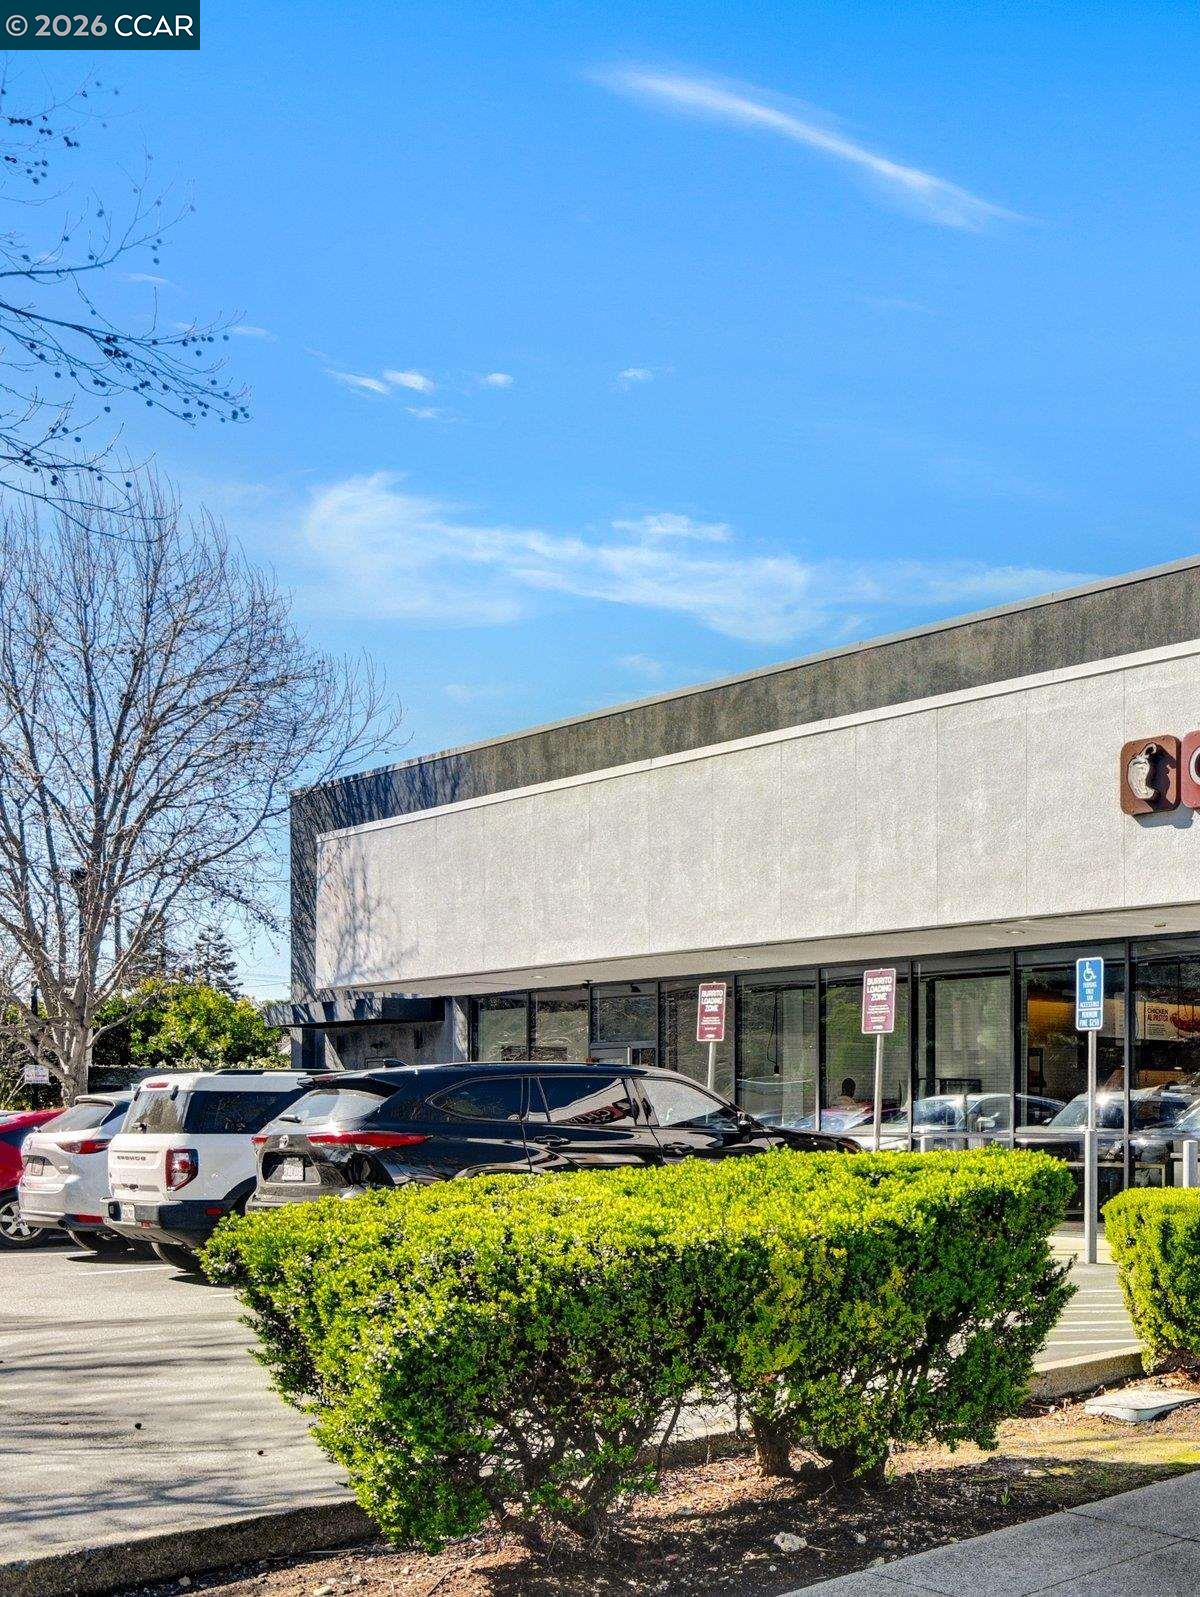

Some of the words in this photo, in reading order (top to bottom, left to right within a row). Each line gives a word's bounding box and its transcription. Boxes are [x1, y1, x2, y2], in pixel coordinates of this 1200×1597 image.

[866, 976, 892, 985] BURRITO
[866, 985, 892, 993] LOADING
[871, 993, 887, 1001] ZONE
